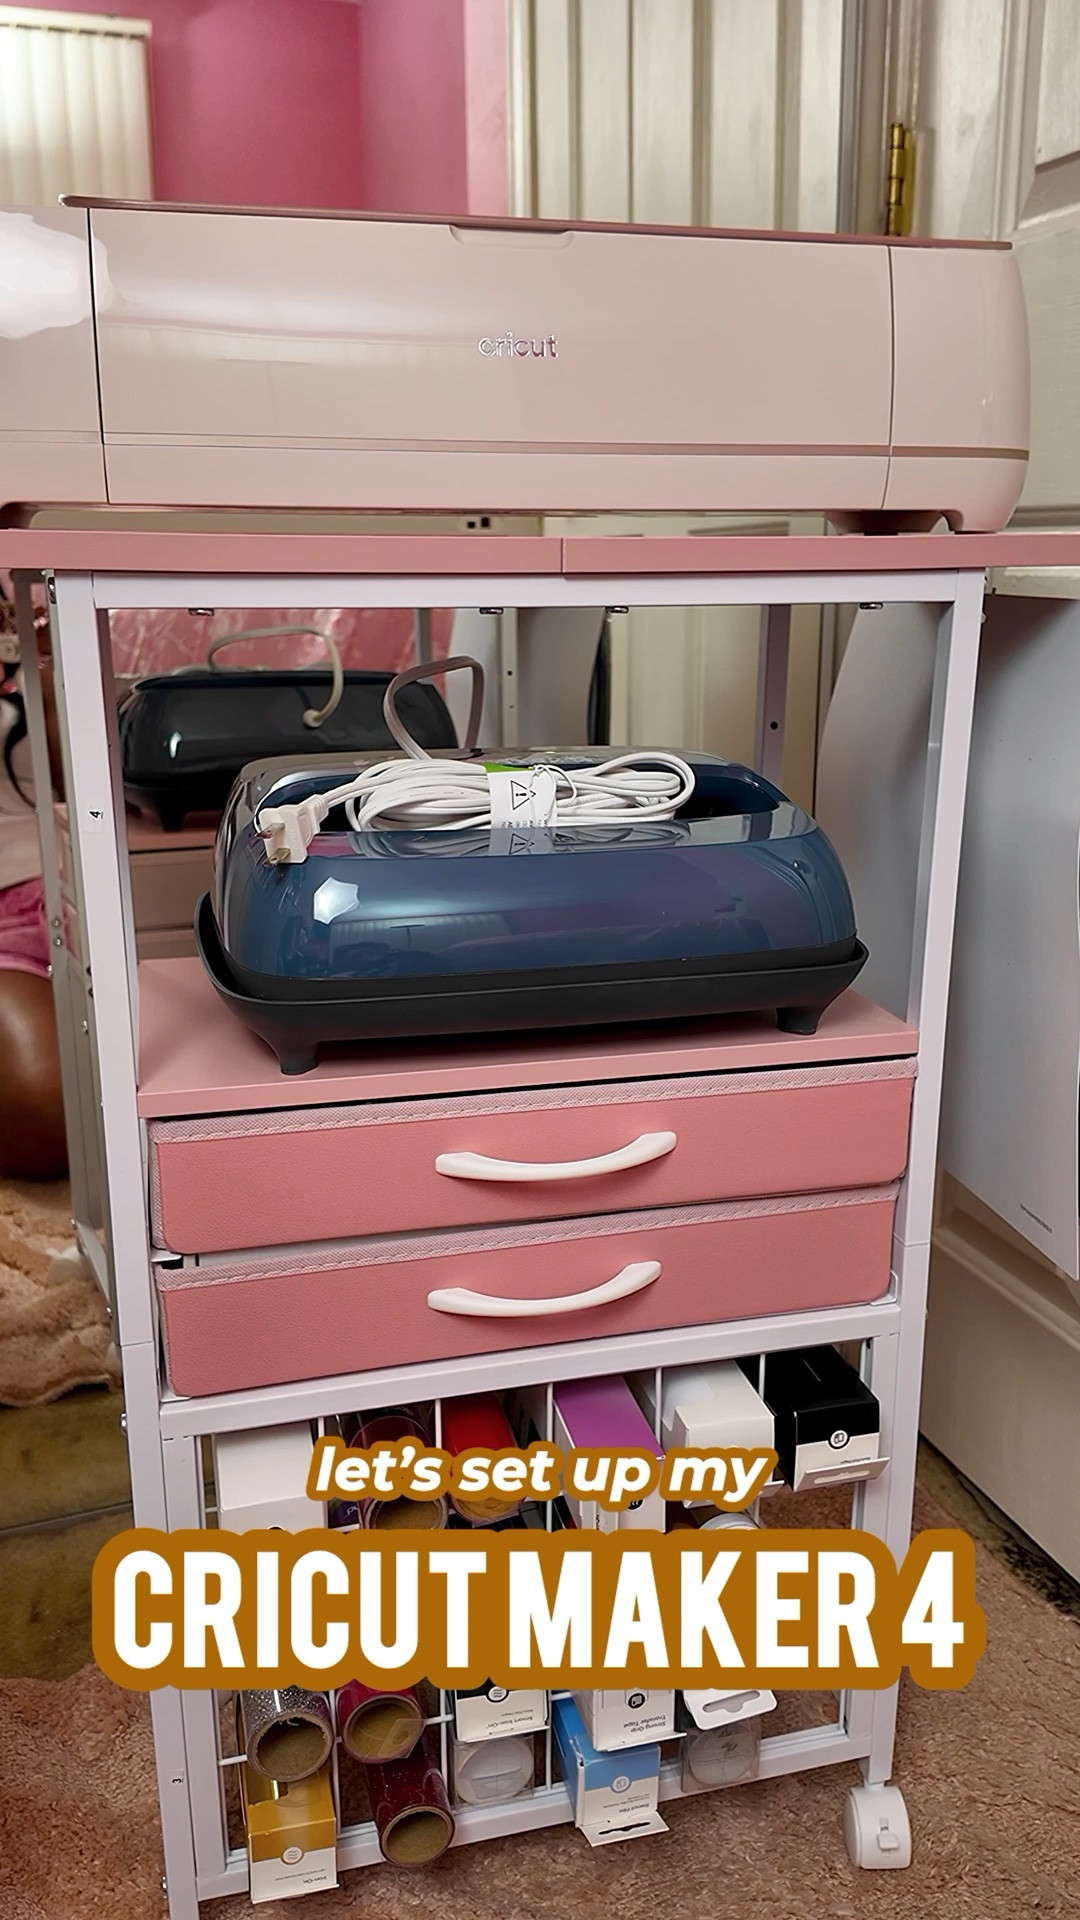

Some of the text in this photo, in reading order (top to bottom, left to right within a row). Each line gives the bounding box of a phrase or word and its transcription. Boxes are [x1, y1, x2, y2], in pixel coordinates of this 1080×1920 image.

[478, 331, 559, 358] cricut
[623, 1714, 666, 1728] Transfer Tape
[645, 1721, 666, 1730] Strong
